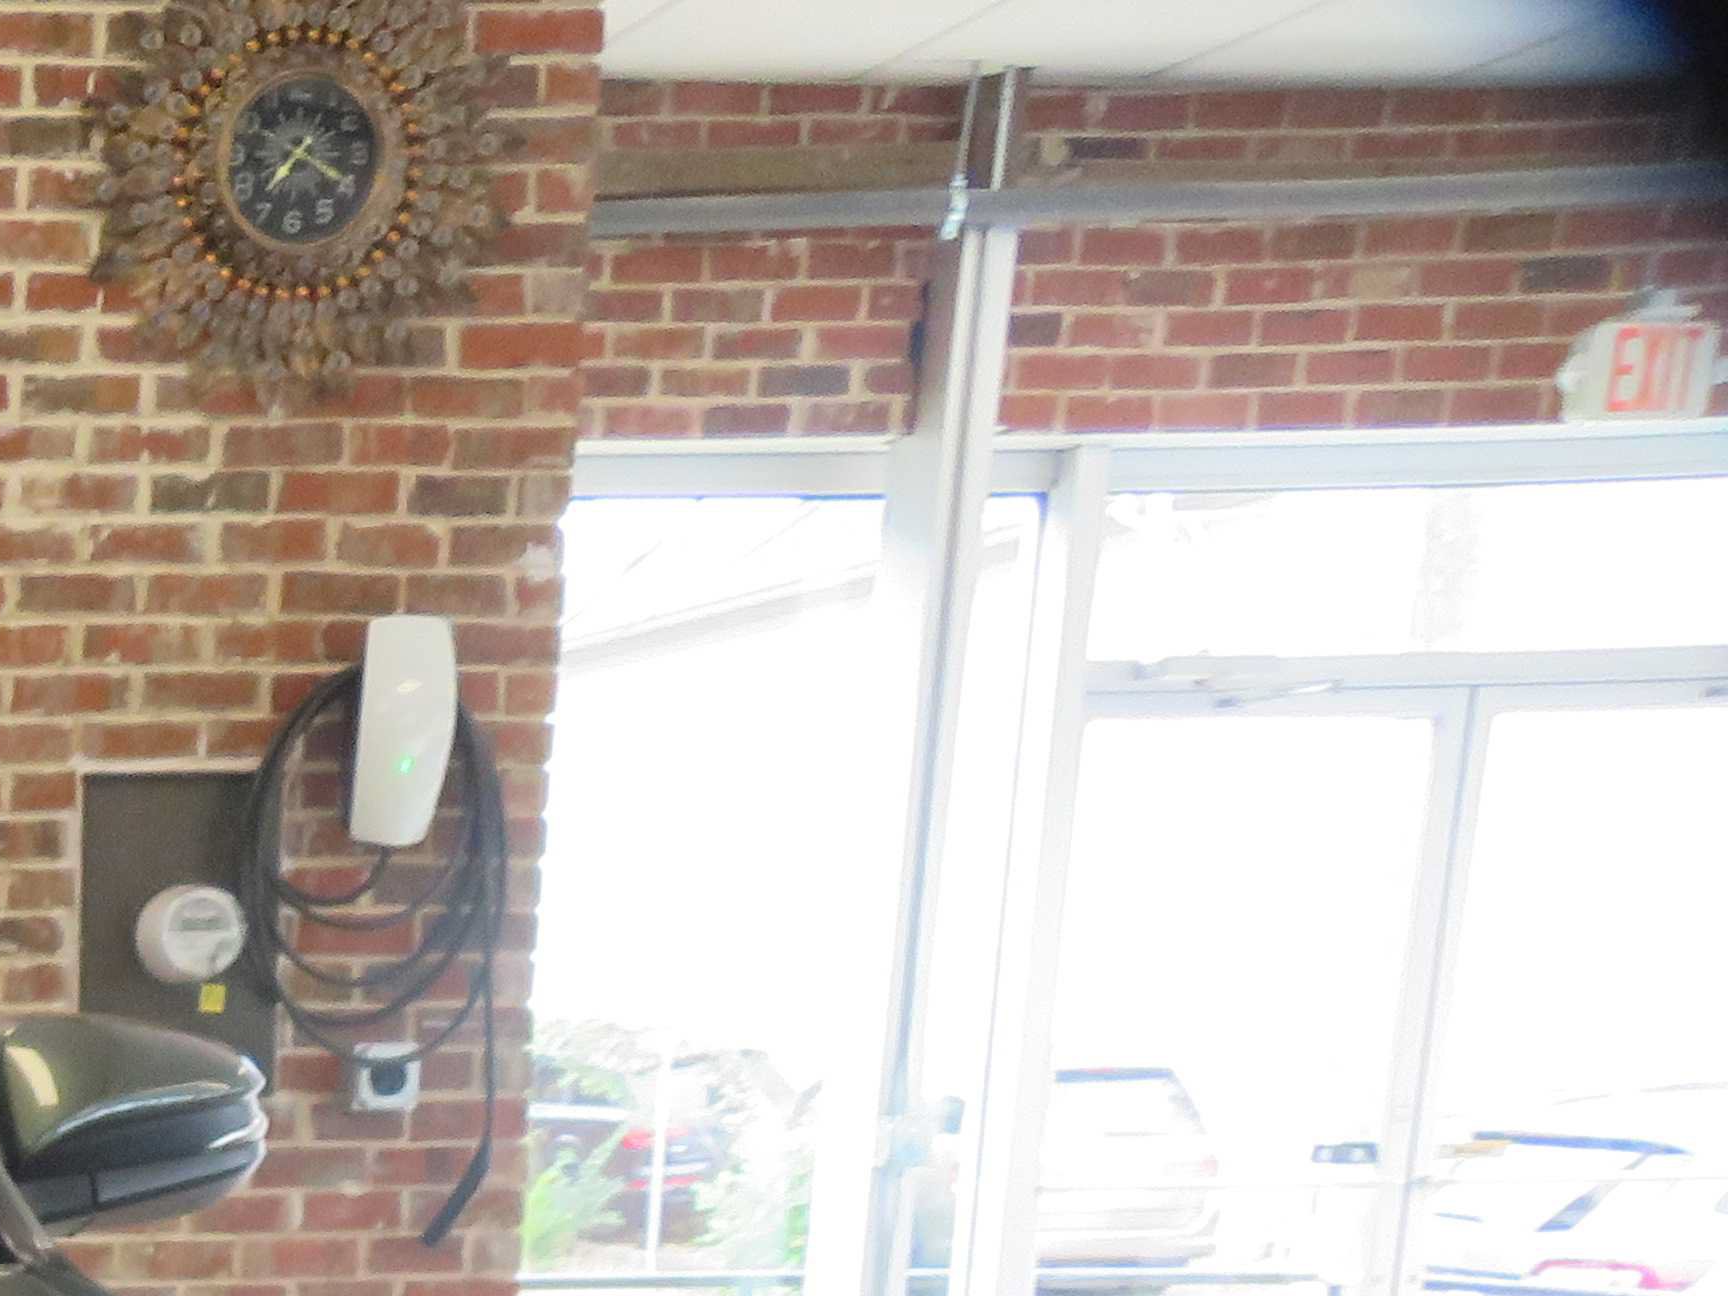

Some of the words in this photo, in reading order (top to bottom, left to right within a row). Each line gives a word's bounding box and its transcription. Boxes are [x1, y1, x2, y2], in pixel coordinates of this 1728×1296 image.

[235, 172, 254, 201] 8
[255, 201, 273, 225] 7
[282, 209, 303, 234] 6
[315, 198, 335, 224] 5
